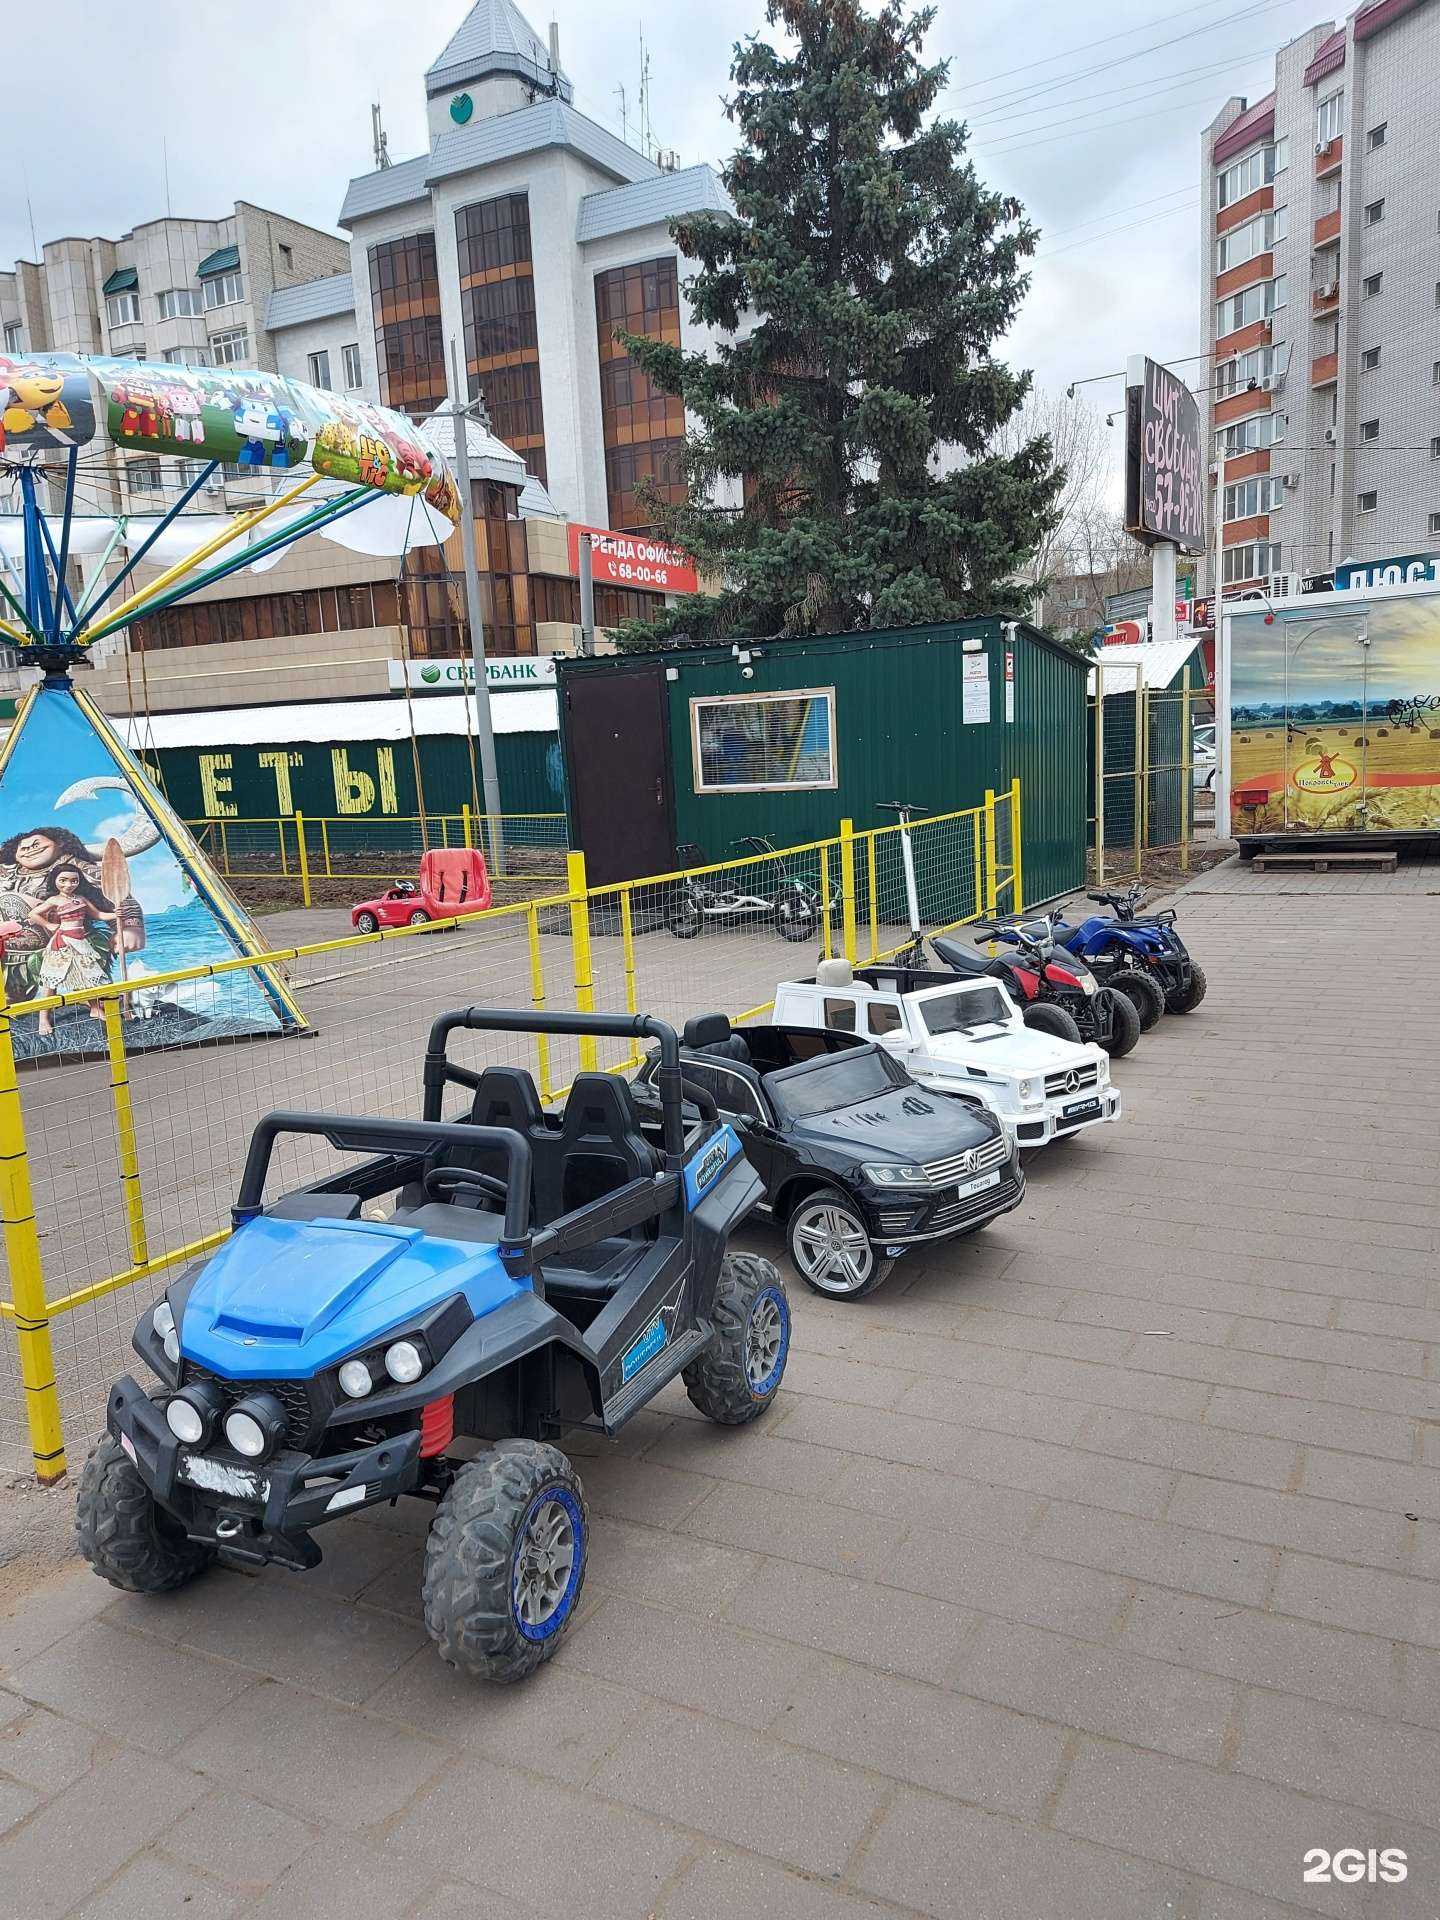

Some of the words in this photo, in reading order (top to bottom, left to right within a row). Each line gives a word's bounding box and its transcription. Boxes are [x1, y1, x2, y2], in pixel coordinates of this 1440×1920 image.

[590, 533, 636, 560] РЕНДА
[618, 562, 668, 585] 68-00-66
[145, 747, 398, 817] ЕТЫ
